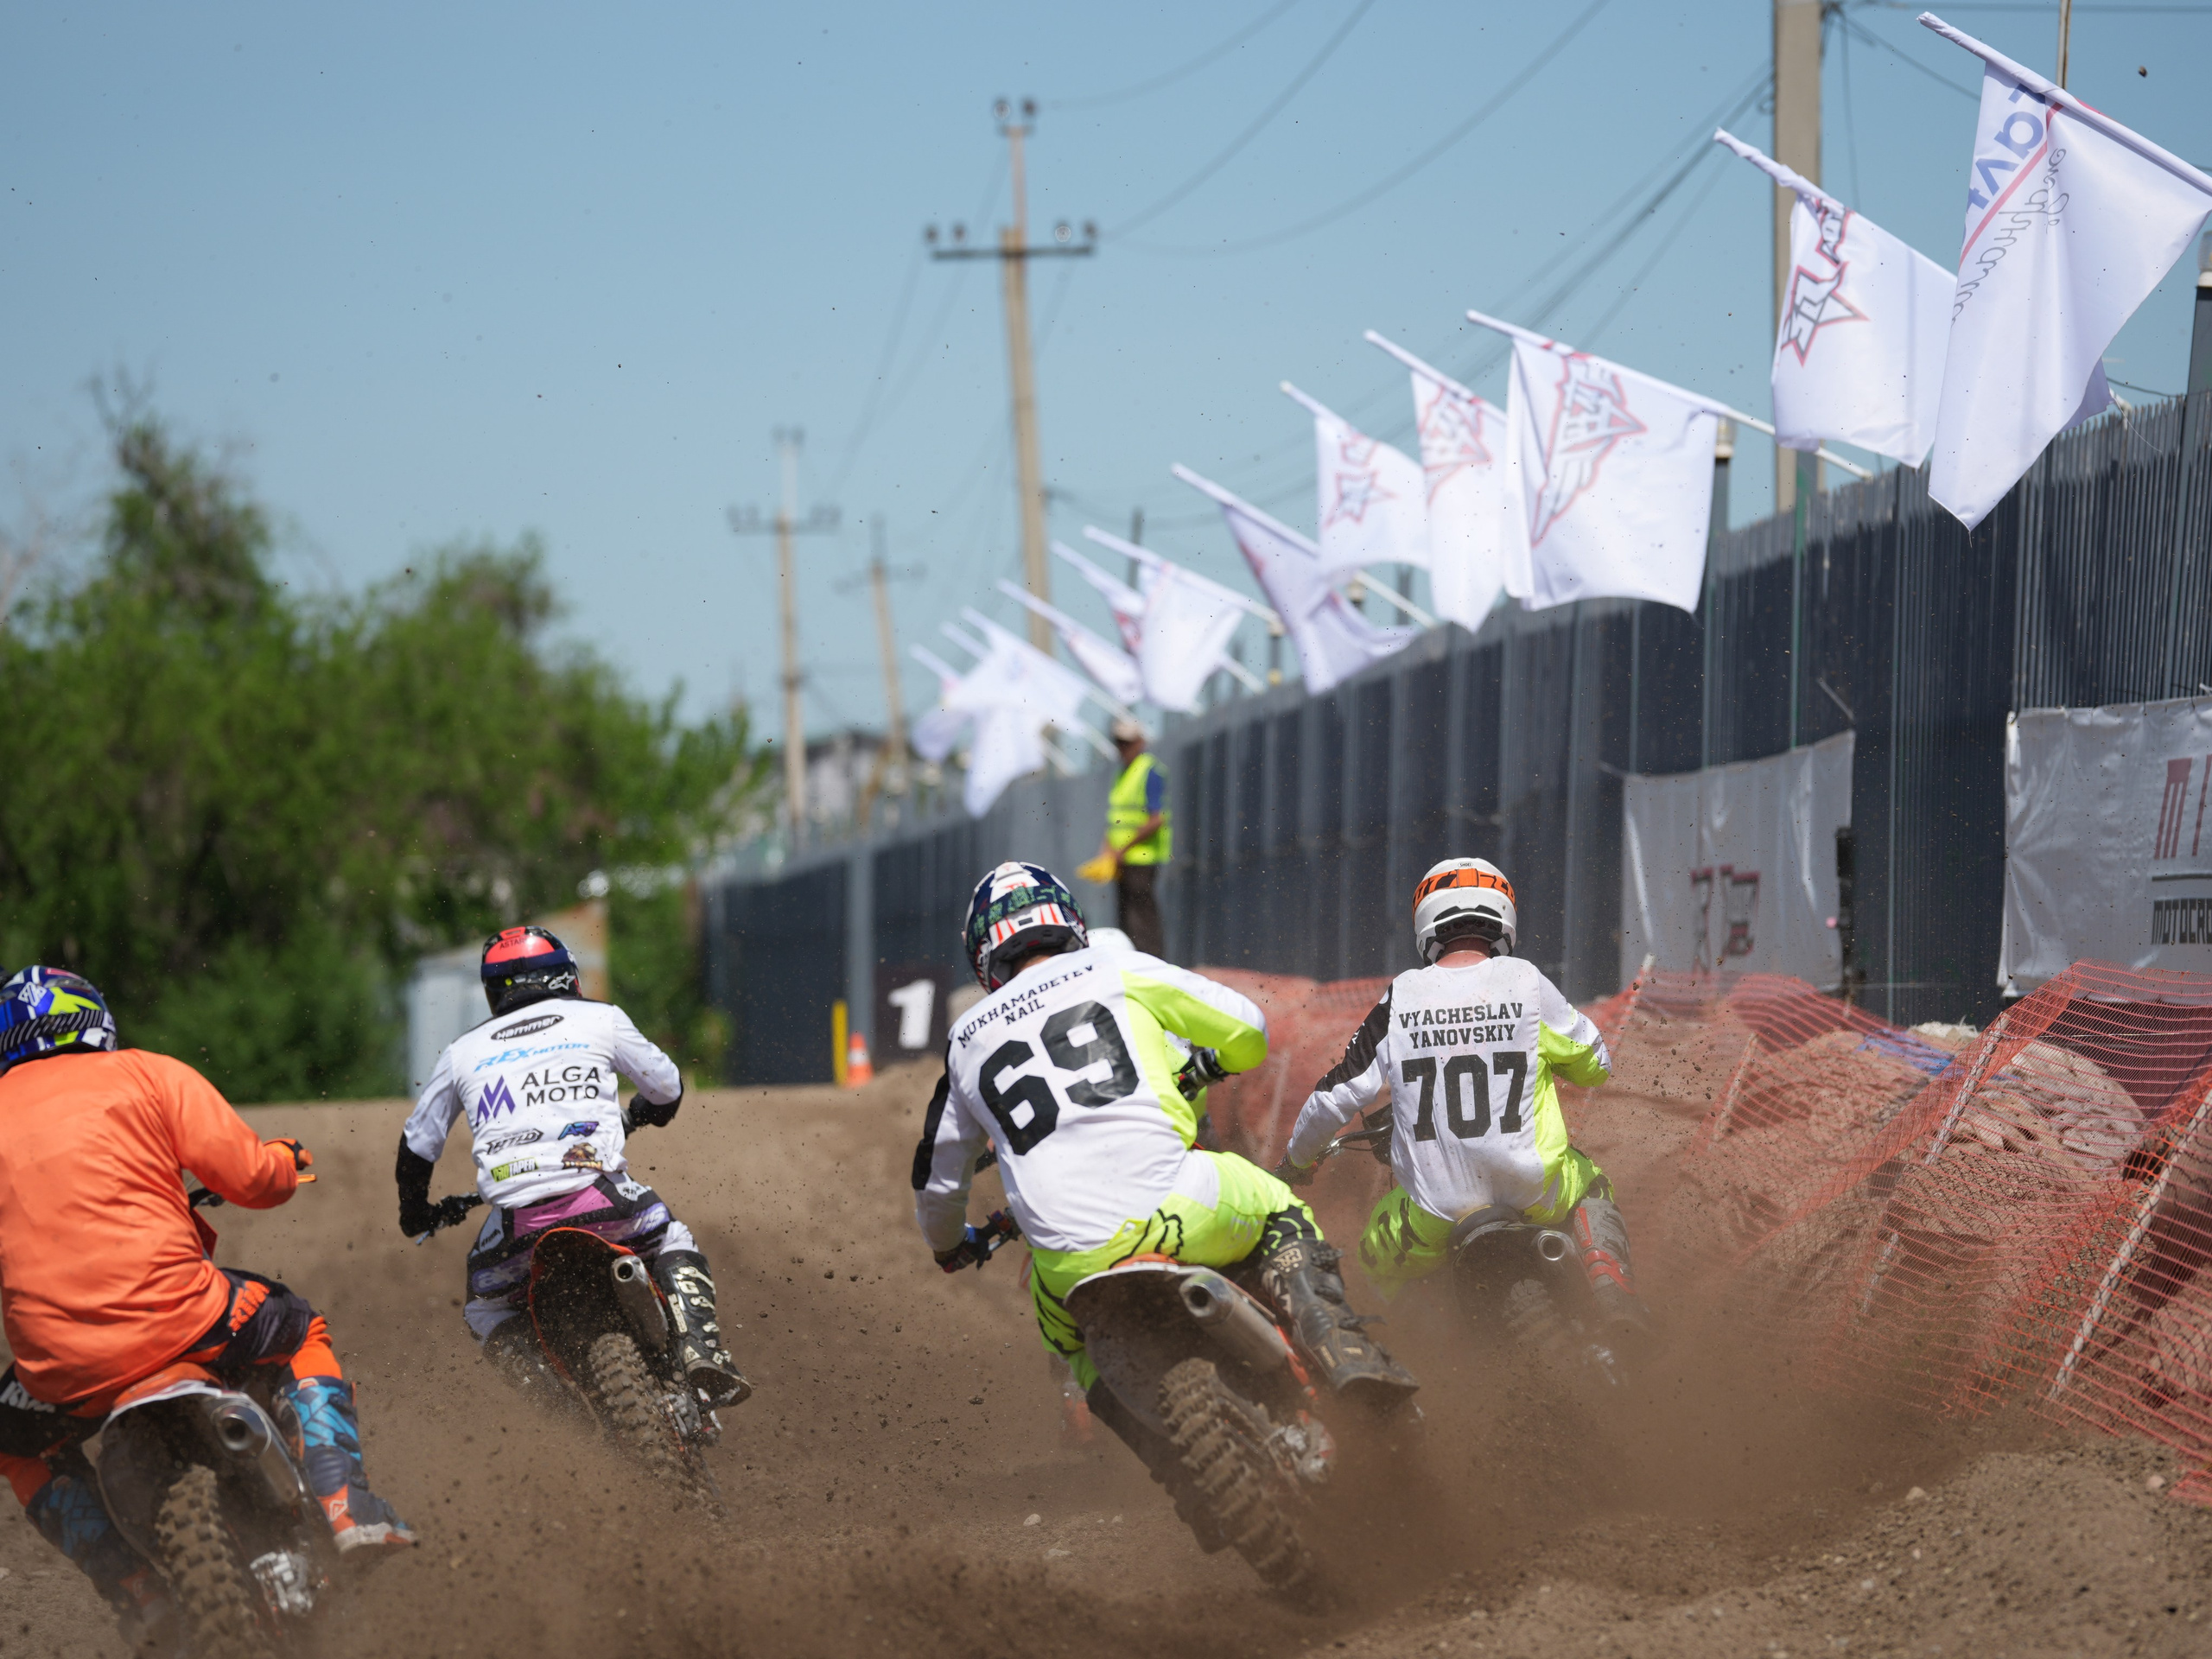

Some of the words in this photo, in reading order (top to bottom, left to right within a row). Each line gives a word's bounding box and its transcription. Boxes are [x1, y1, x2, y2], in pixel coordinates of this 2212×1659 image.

[499, 937, 531, 950] ASTAR
[887, 978, 936, 1049] 1
[957, 964, 1095, 1049] MUKHAMADEYEV
[1004, 998, 1046, 1026] NAIL
[1399, 1002, 1522, 1029] VYACHESLAV
[1409, 1024, 1516, 1049] YANOVSKIY
[474, 1046, 534, 1073] REX
[520, 1065, 601, 1090] ALGA
[978, 1000, 1140, 1156] 69
[526, 1084, 600, 1107] MOTO
[1401, 1051, 1529, 1142] 707
